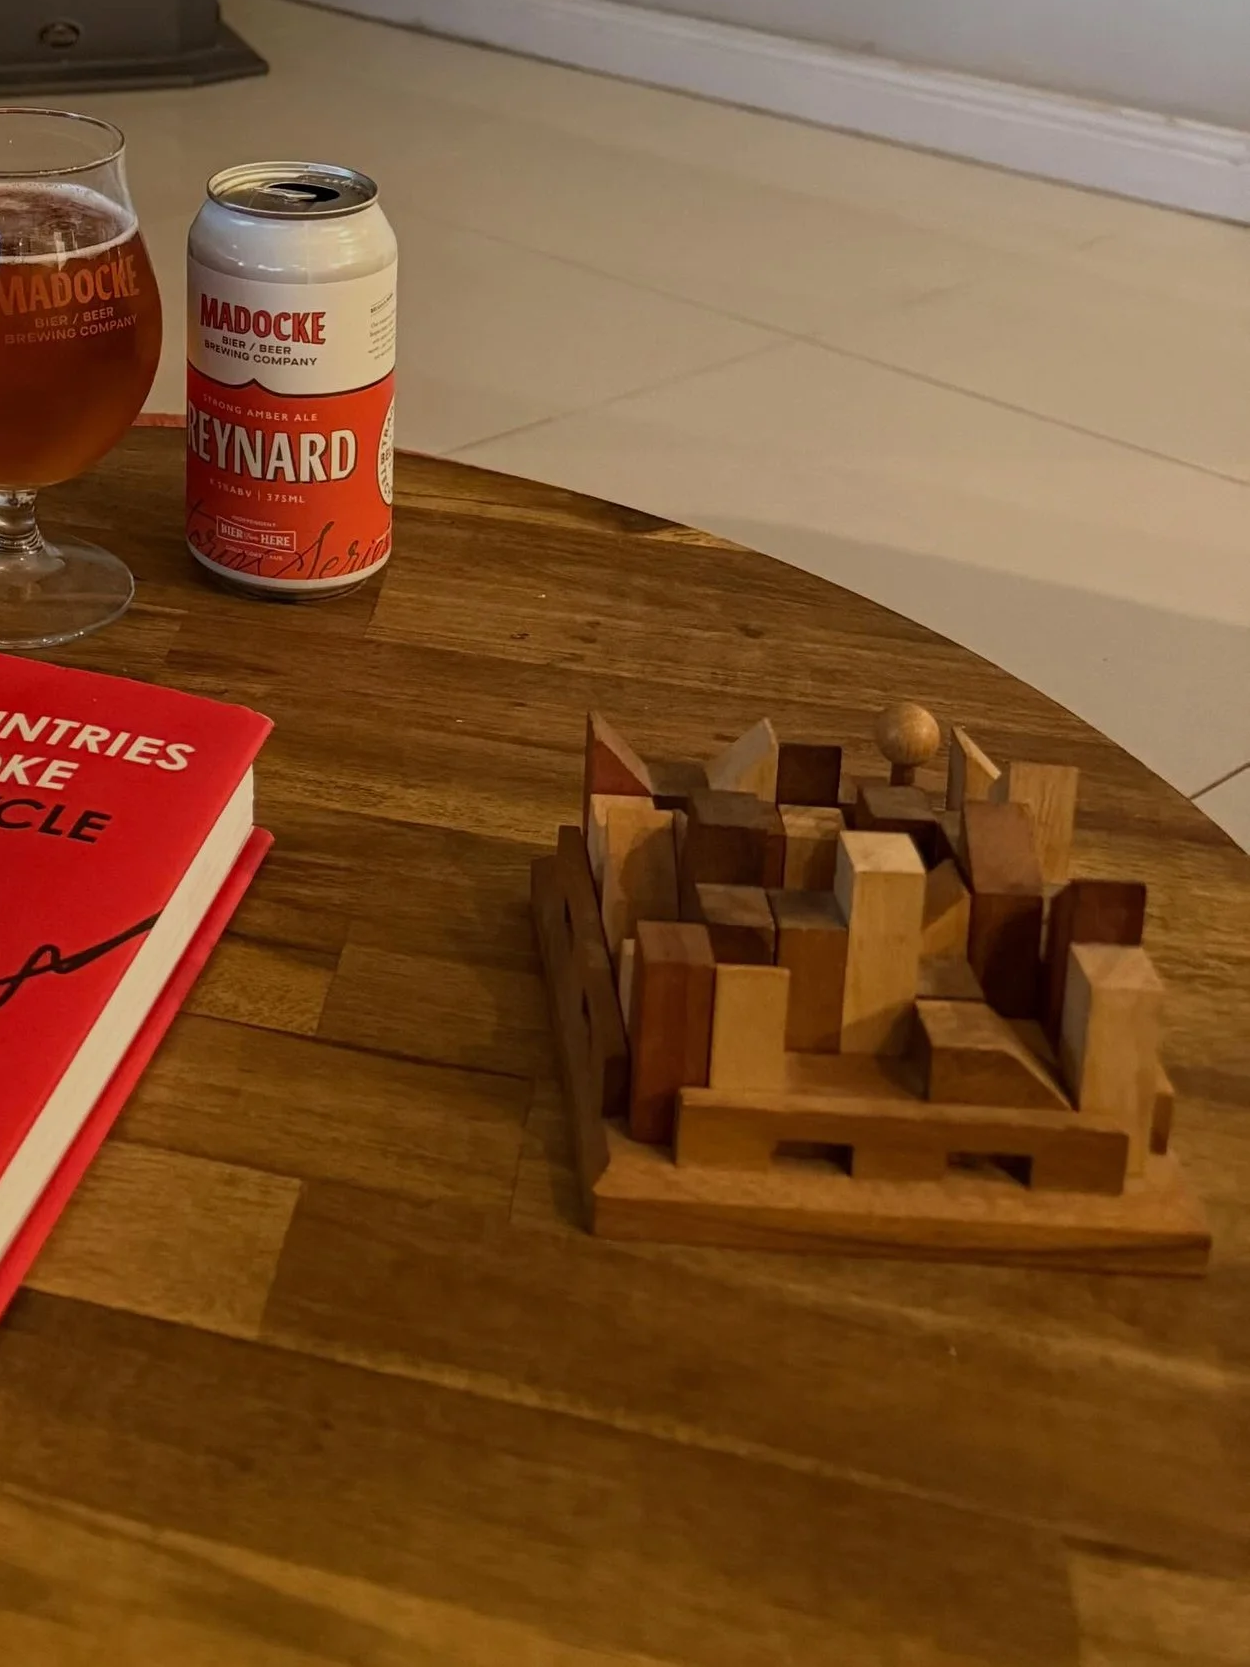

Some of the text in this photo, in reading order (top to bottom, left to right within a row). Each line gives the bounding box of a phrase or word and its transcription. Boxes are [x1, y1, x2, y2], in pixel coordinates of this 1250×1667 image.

[4, 313, 138, 345] BREWING COMPANY
[35, 313, 68, 328] BIER
[83, 307, 114, 322] BEER
[200, 293, 327, 345] MADOCKE
[204, 339, 317, 366] BREWING COMPANY
[221, 335, 246, 350] BIER
[259, 345, 292, 355] BEER
[202, 393, 318, 422] STRONG AMBER ALE
[187, 399, 357, 483] REYNARD
[260, 534, 291, 547] HERE
